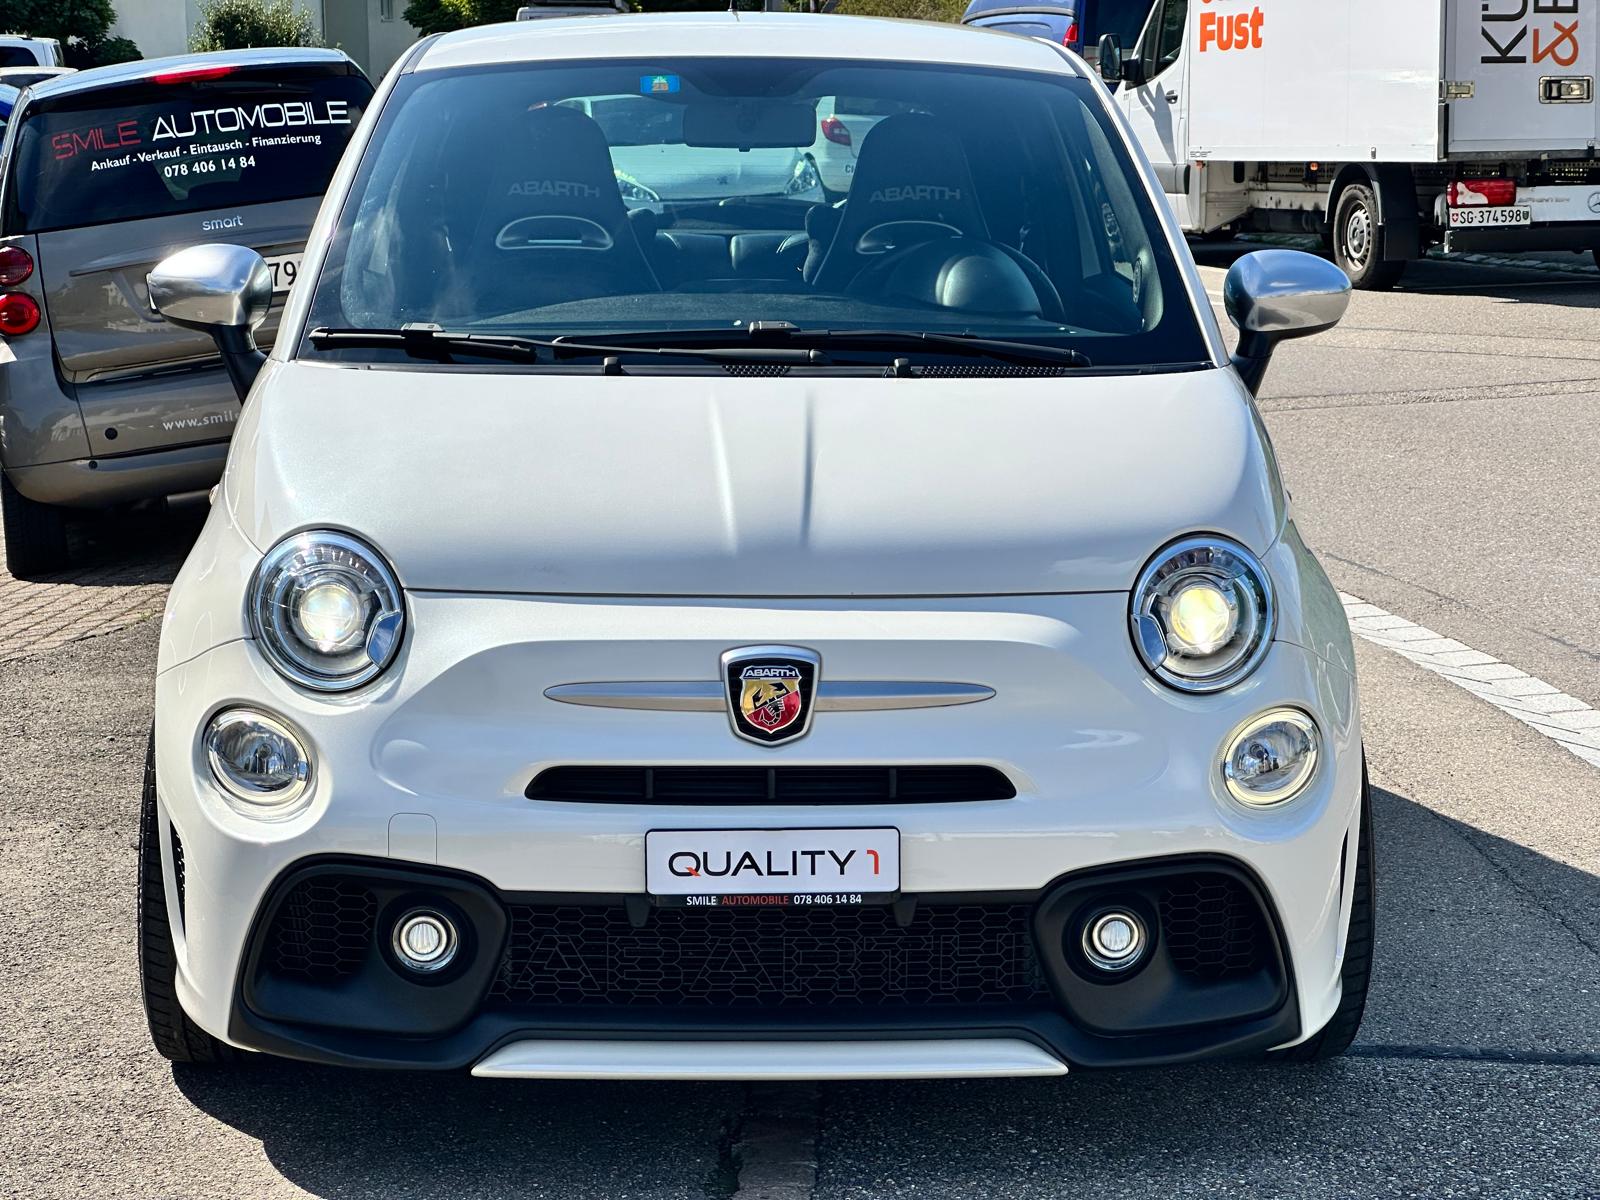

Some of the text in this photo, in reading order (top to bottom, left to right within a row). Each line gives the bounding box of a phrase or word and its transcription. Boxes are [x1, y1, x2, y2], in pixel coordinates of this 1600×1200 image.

[1199, 6, 1264, 52] Fust
[51, 101, 352, 160] SMILE AUTOMOBILE
[91, 155, 131, 172] Ankauf
[137, 146, 181, 163] Verkauf
[190, 139, 243, 155] Eintausch
[252, 133, 322, 148] Finanzierung
[164, 155, 256, 178] 078 406 14 84
[507, 180, 601, 198] ABARTH
[868, 184, 961, 203] ABARTH
[202, 215, 244, 231] smart
[267, 260, 302, 288] 79
[745, 668, 796, 677] ABARTH
[668, 849, 857, 877] QUALITY
[686, 894, 862, 906] SMILE AUTOMOBILE 078 406 14 84
